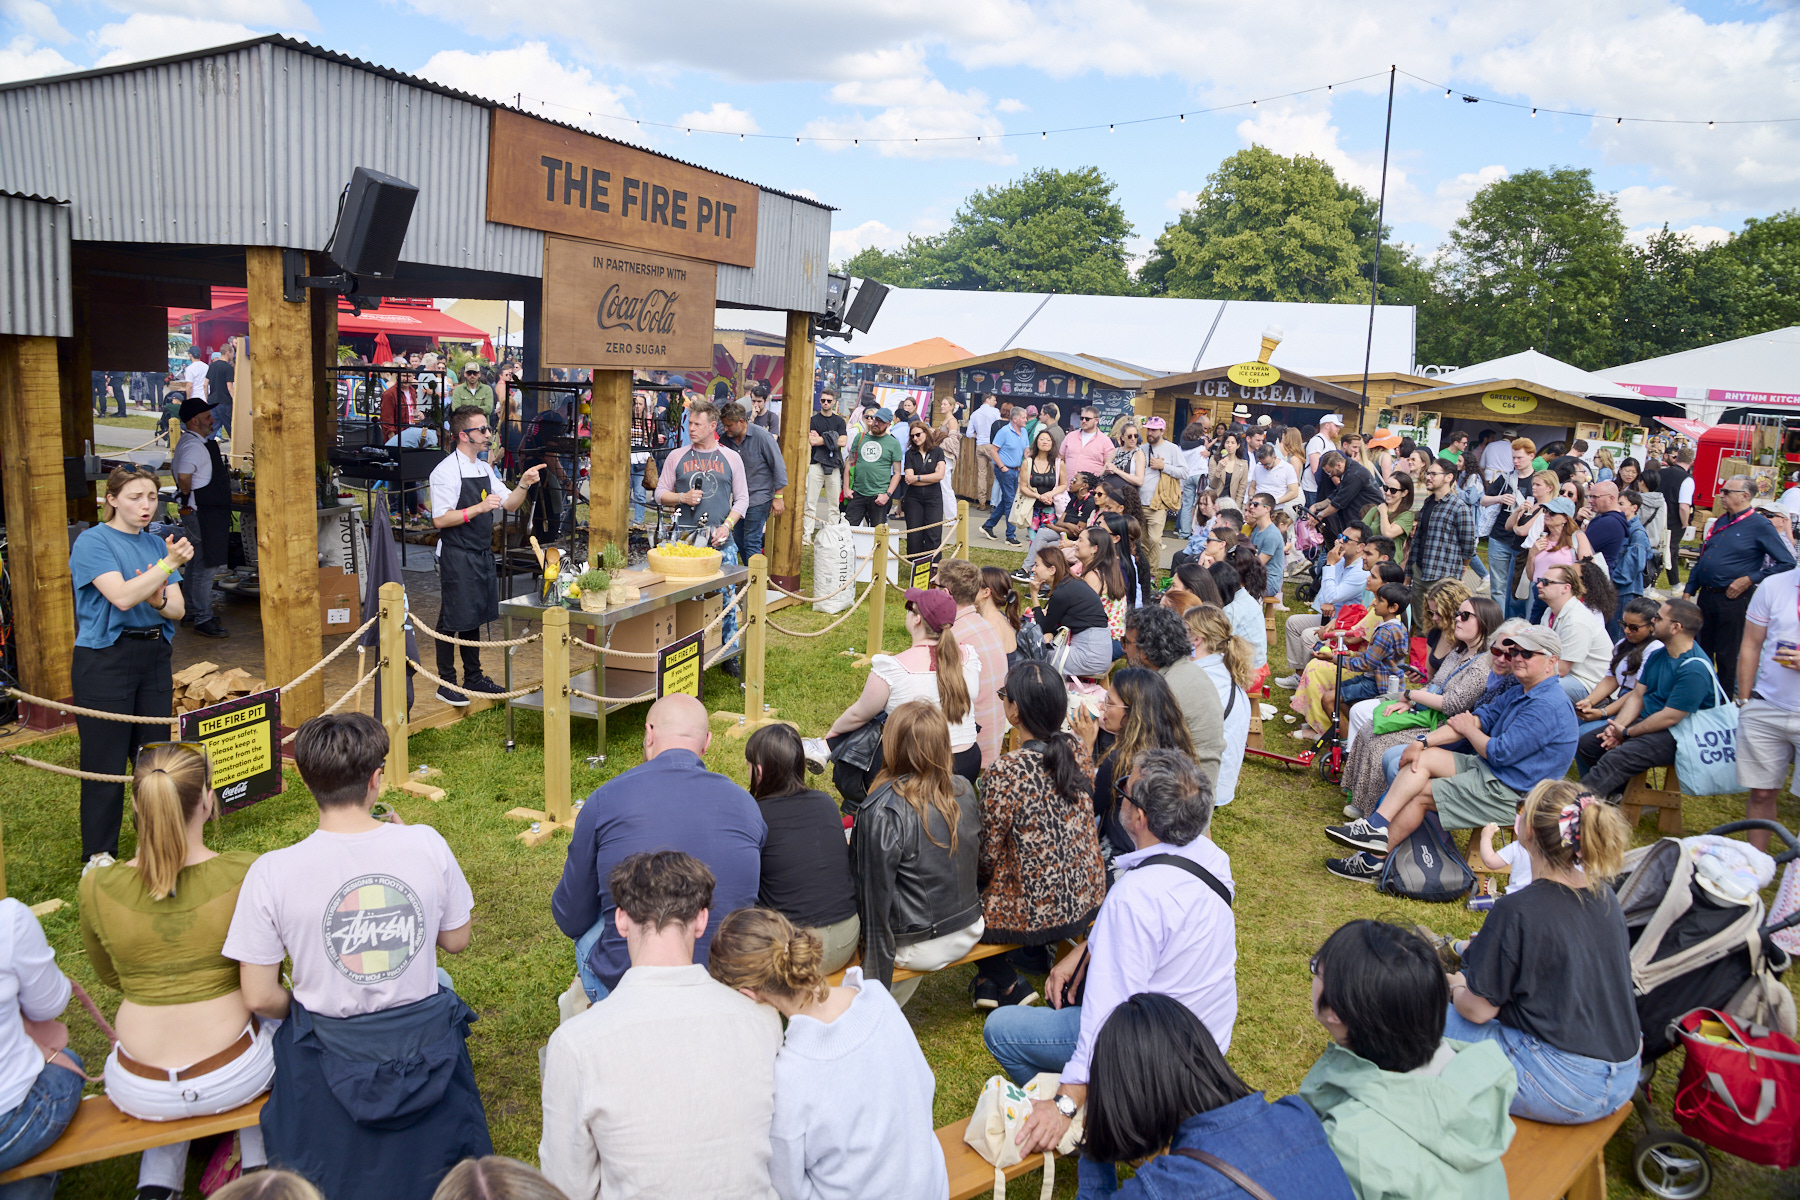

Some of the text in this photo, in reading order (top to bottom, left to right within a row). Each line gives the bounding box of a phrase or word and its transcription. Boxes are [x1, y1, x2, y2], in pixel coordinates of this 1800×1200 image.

[541, 155, 736, 238] THE FIRE PIT
[593, 256, 686, 280] IN PARTNERSHIP WITH
[597, 284, 679, 334] Coca-Cola
[606, 342, 666, 355] ZERO SUGAR
[1194, 380, 1316, 404] ICE CREAM
[1725, 392, 1767, 402] RHYTHM
[683, 459, 725, 475] NIRVANA
[668, 654, 676, 664] THE
[678, 648, 688, 660] FIRE
[202, 707, 262, 732] THE FIRE PIT
[222, 735, 236, 745] your
[212, 746, 233, 758] please
[235, 740, 250, 749] keep
[236, 750, 250, 758] from
[213, 758, 251, 775] monstration
[214, 763, 264, 785] smoke and dust
[343, 878, 373, 895] DESIGNS
[379, 878, 403, 892] ROOTS
[326, 897, 341, 926] STUSSY
[407, 893, 423, 922] REGGAE
[349, 972, 365, 981] JAH
[366, 973, 381, 981] FOR
